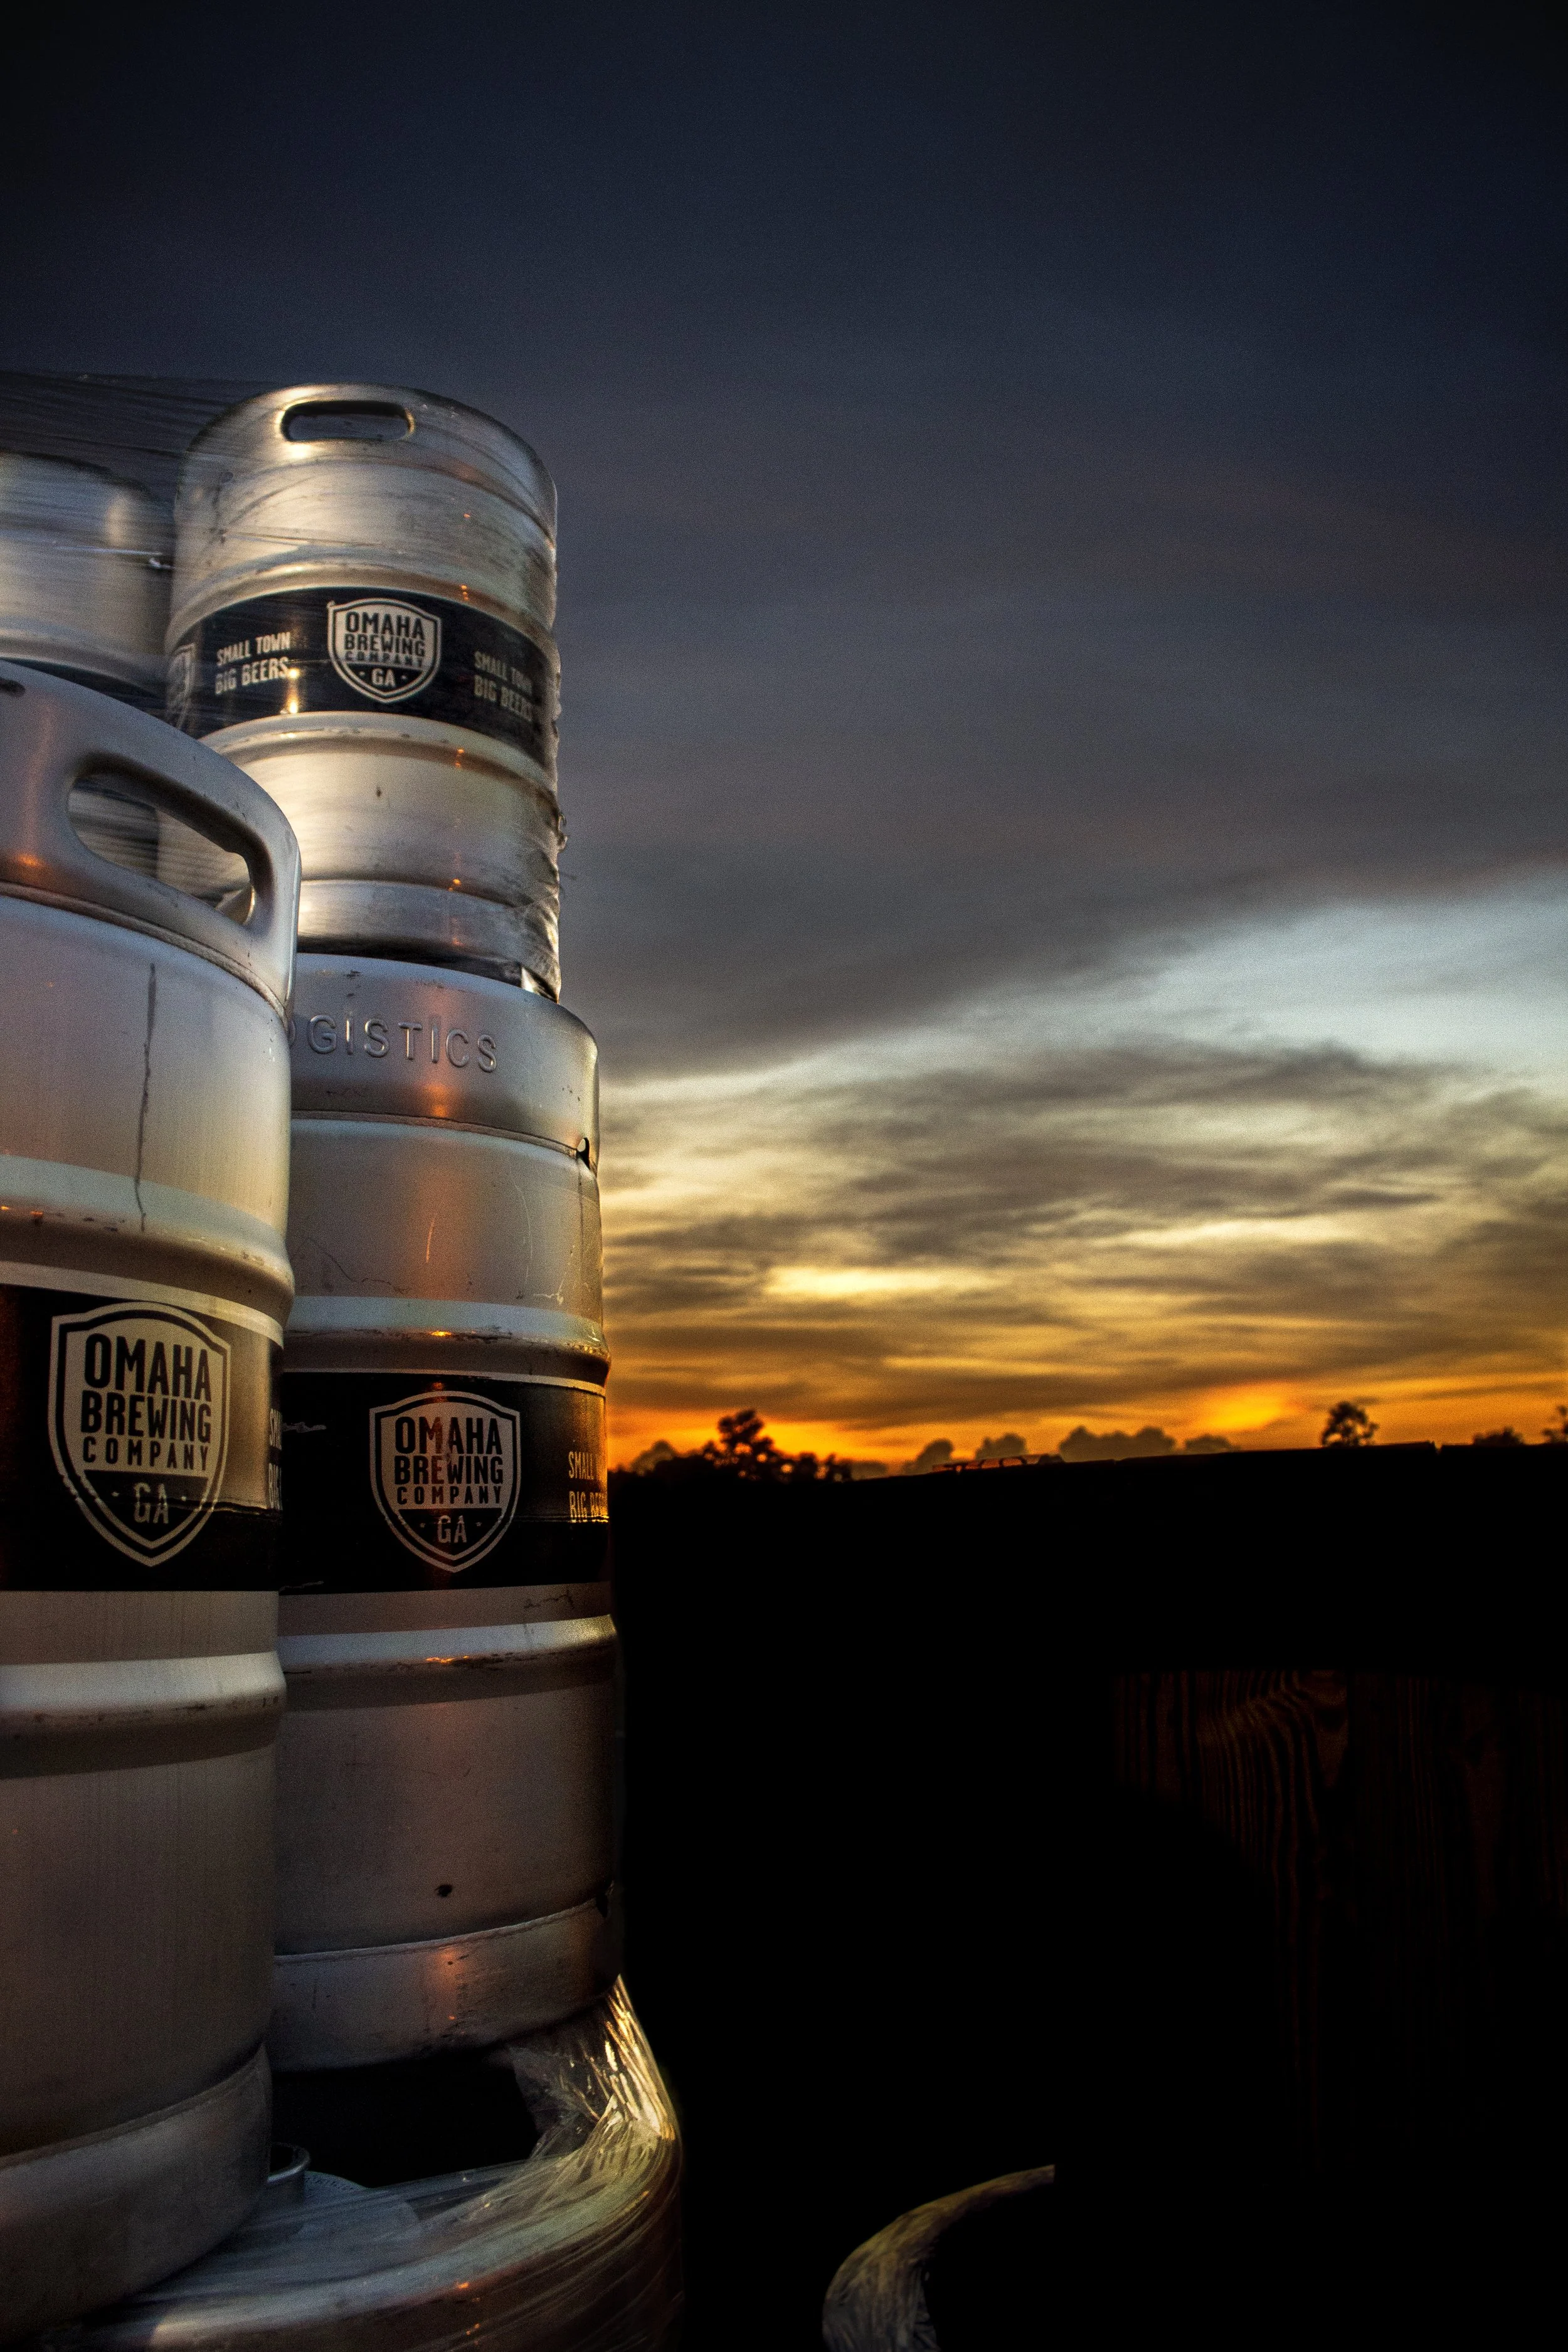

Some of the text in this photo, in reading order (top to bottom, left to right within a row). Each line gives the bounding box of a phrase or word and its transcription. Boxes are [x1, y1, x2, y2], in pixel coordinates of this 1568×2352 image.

[346, 611, 425, 640] OMAHA
[217, 632, 290, 667] SMALL TOWN
[345, 633, 425, 657] BREWING
[345, 650, 423, 667] COMPANY
[215, 668, 237, 695] BIG
[241, 656, 290, 686] BEERS
[371, 667, 396, 687] GA
[474, 651, 507, 681] SMALL
[474, 675, 497, 702] BIG
[84, 1333, 211, 1402] OMAHA
[81, 1390, 211, 1444] BREWING
[395, 1416, 502, 1454] OMAHA
[83, 1436, 209, 1471] COMPANY
[568, 1451, 595, 1479] SMALL
[395, 1456, 502, 1484] BREWING
[134, 1482, 169, 1524] GA
[397, 1486, 501, 1505] COMPANY
[569, 1490, 588, 1523] BIG
[438, 1515, 467, 1542] GA
